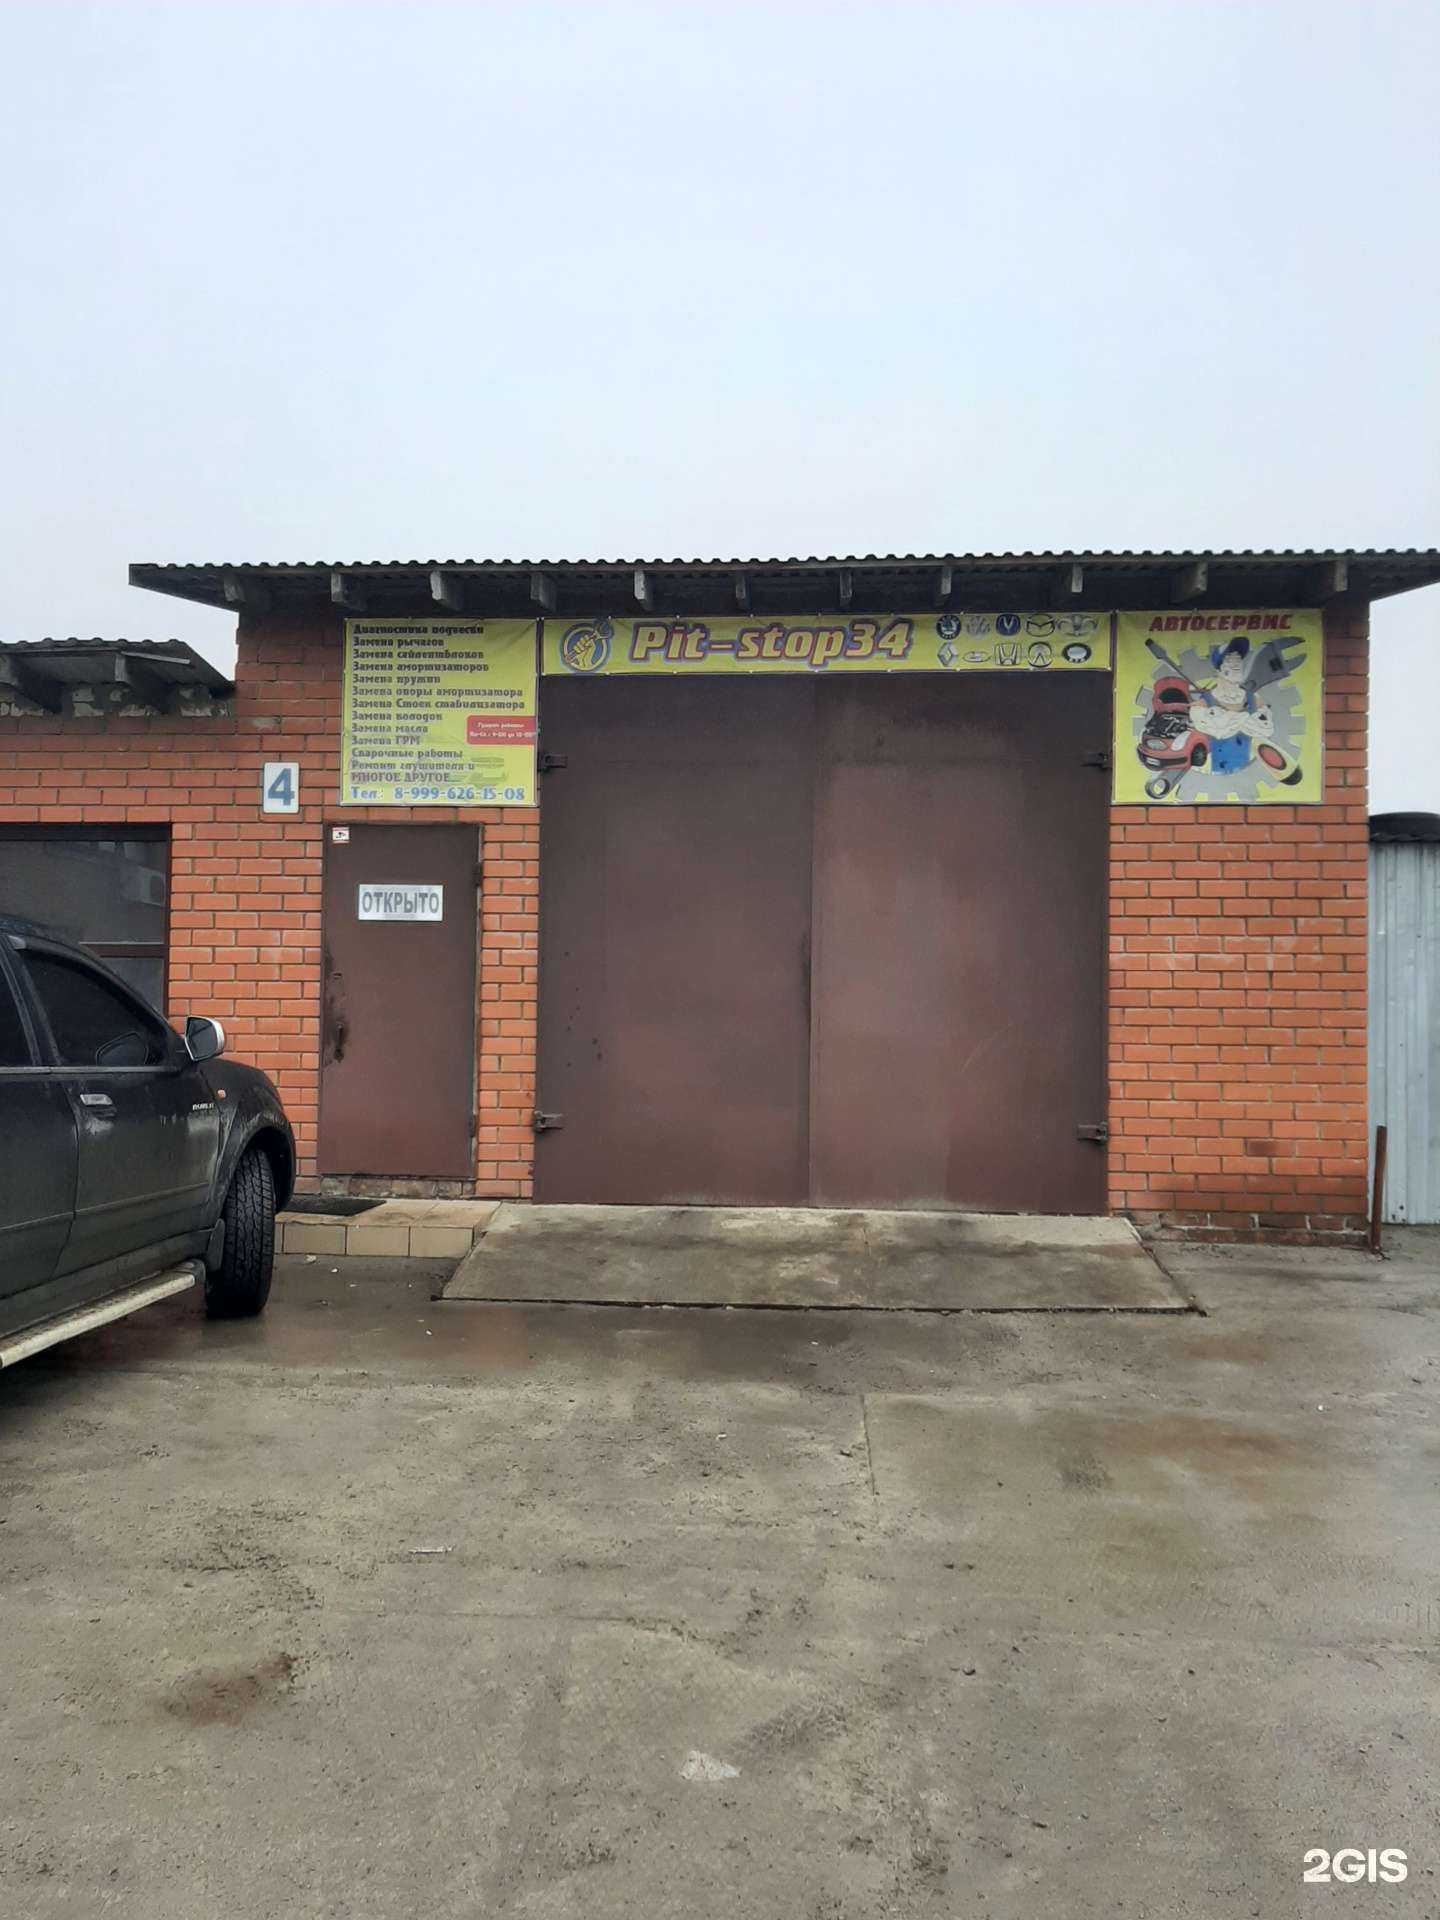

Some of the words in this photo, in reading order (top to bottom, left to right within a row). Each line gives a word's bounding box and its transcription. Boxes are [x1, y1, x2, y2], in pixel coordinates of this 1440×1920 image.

[1149, 614, 1293, 632] АВТОСЕРВИС
[352, 637, 394, 646] Замена
[397, 638, 444, 648] рычагов
[631, 619, 913, 670] Pit-stop34
[352, 649, 394, 659] Замена
[352, 662, 393, 671] Замена
[397, 663, 489, 672] амортизаторов
[352, 674, 393, 684] Замена
[396, 676, 441, 686] пружин
[352, 687, 392, 696] Замена
[396, 688, 433, 698] опоры
[436, 688, 523, 698] амортизатора
[352, 699, 392, 708] Замена
[396, 699, 432, 709] Стоек
[435, 699, 525, 710] стабилизатора
[352, 711, 392, 721] Замена
[396, 712, 443, 722] колодок
[351, 723, 392, 733] Замена
[396, 724, 429, 733] масла
[351, 735, 392, 745] Замена
[395, 735, 421, 745] ГРМ
[351, 748, 414, 759] Сварочные
[417, 748, 463, 760] работы
[351, 760, 396, 770] Ремонт
[400, 761, 465, 771] глушителя
[351, 772, 401, 783] МНОГОЕ
[404, 772, 450, 784] ДРУГОЕ
[267, 767, 295, 806] 4
[394, 787, 526, 801] 8-999-626-15-08
[362, 891, 440, 914] ОТКРЫТО
